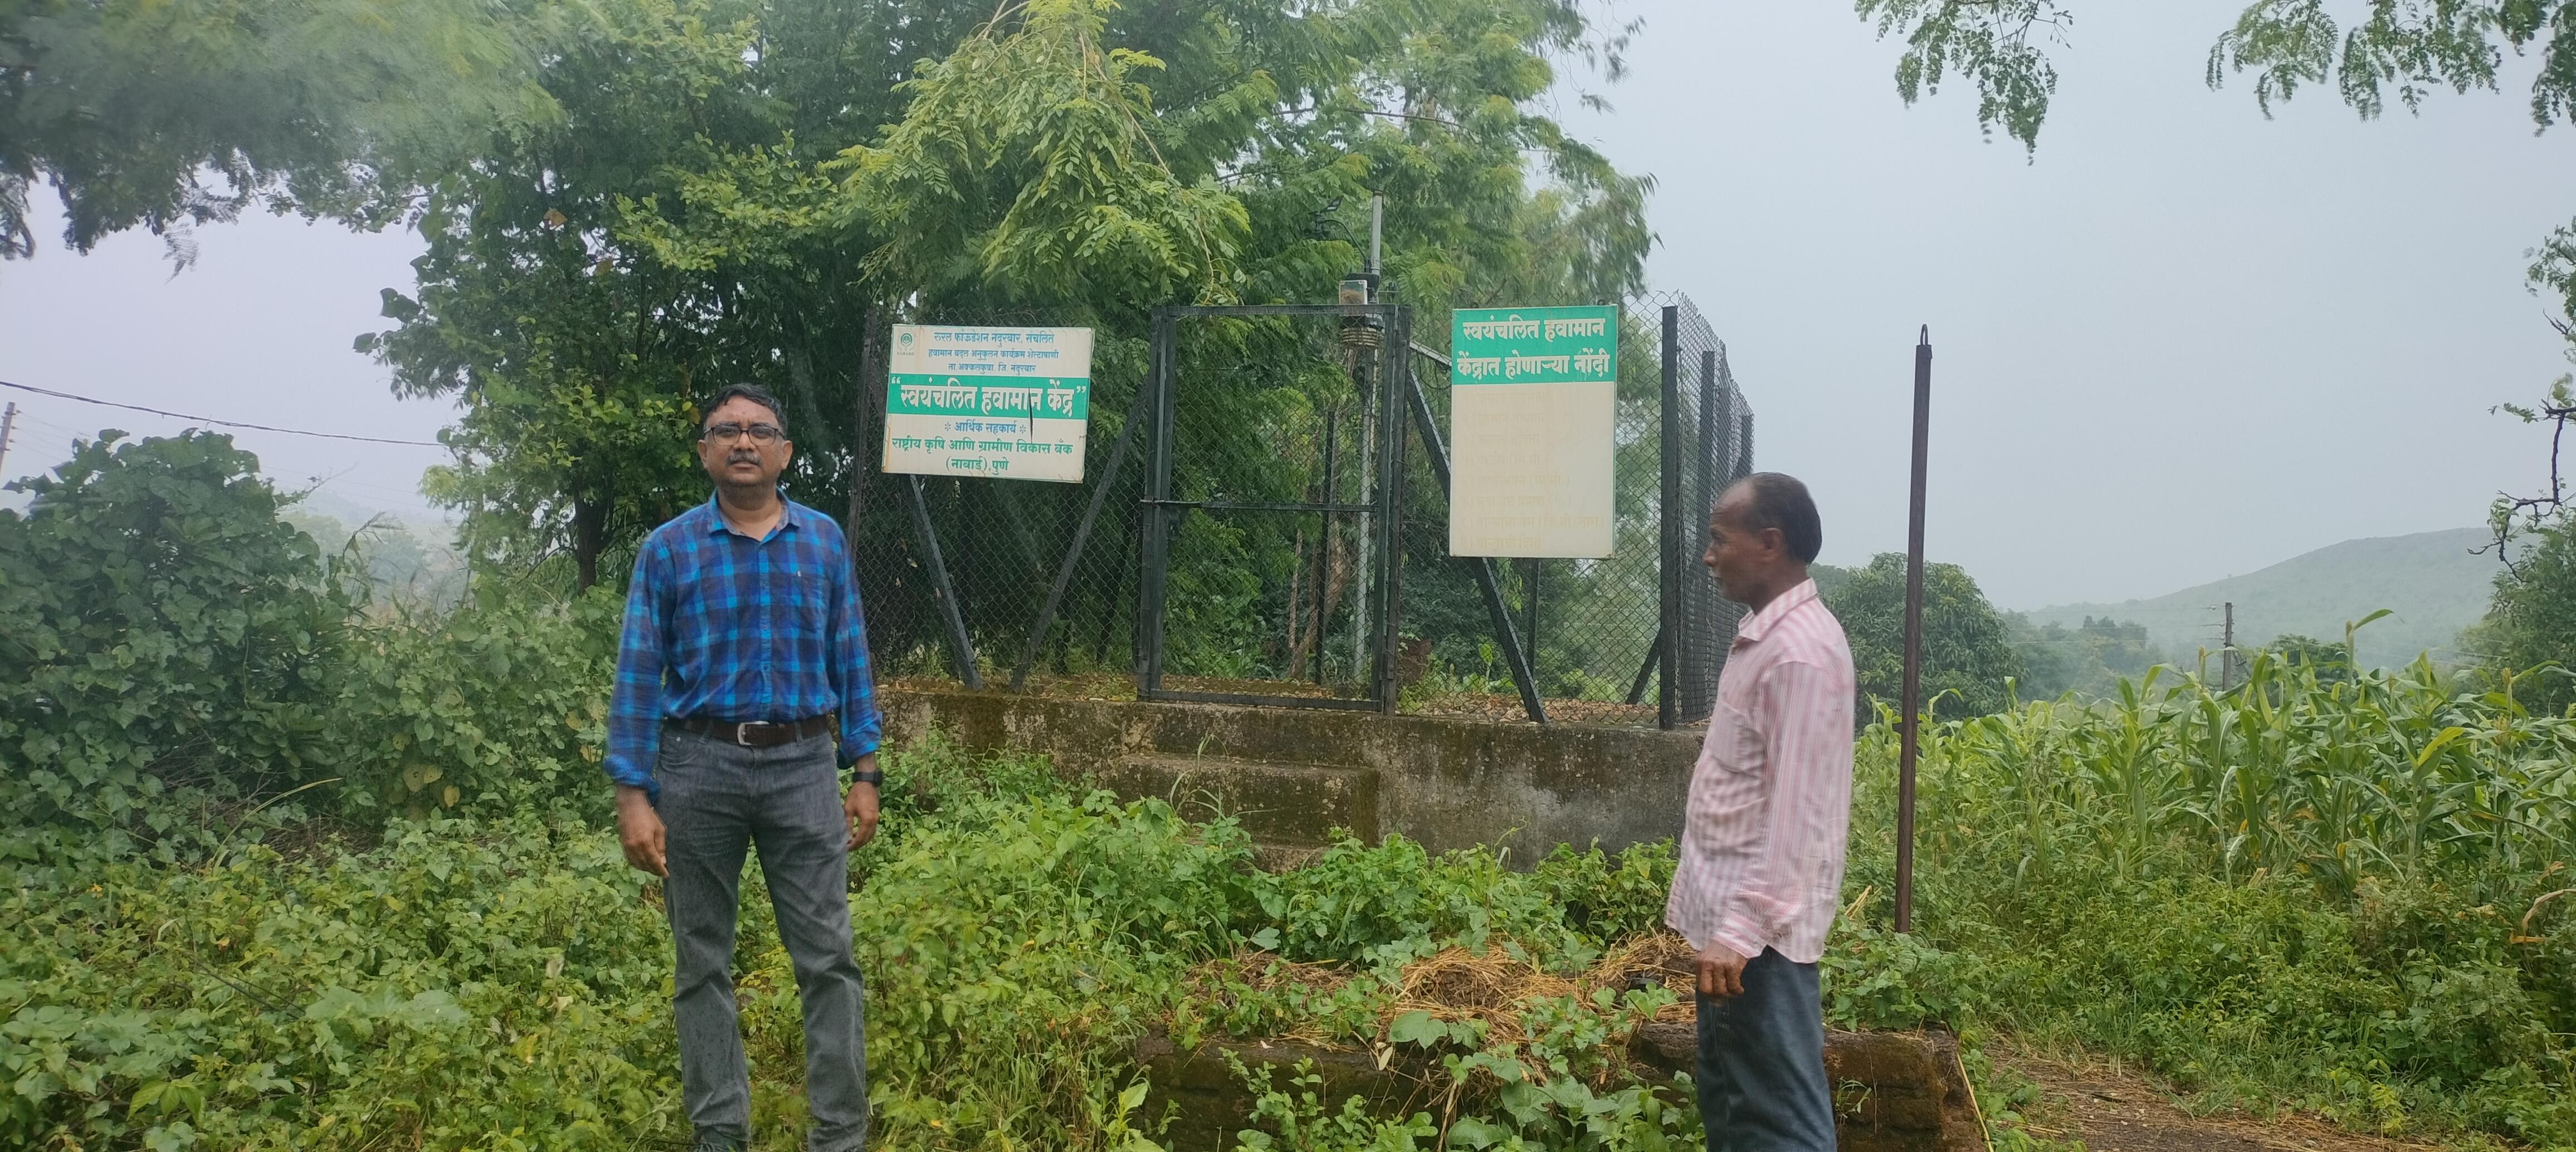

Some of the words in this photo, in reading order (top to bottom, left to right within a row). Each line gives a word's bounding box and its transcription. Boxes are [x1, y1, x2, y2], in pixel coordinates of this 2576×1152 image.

[934, 332, 952, 342] रुरल
[1462, 314, 1540, 340] स्वयंचलित
[1544, 318, 1606, 343] हवामान
[928, 349, 952, 358] हवामान
[1001, 348, 1026, 358] कार्यक्रम
[1456, 350, 1501, 380] केंद्रात
[1574, 347, 1610, 378] नोंदी
[981, 387, 1043, 415] हवामान
[954, 419, 983, 433] आर्थिक
[985, 420, 1017, 435] सहकार्य
[892, 435, 921, 452] राष्ट्रीय
[925, 436, 945, 455] कृषि
[949, 437, 975, 451] आणि
[978, 436, 1013, 452] ग्रामीण
[1016, 438, 1051, 454] विकास
[1054, 438, 1074, 455] बँक
